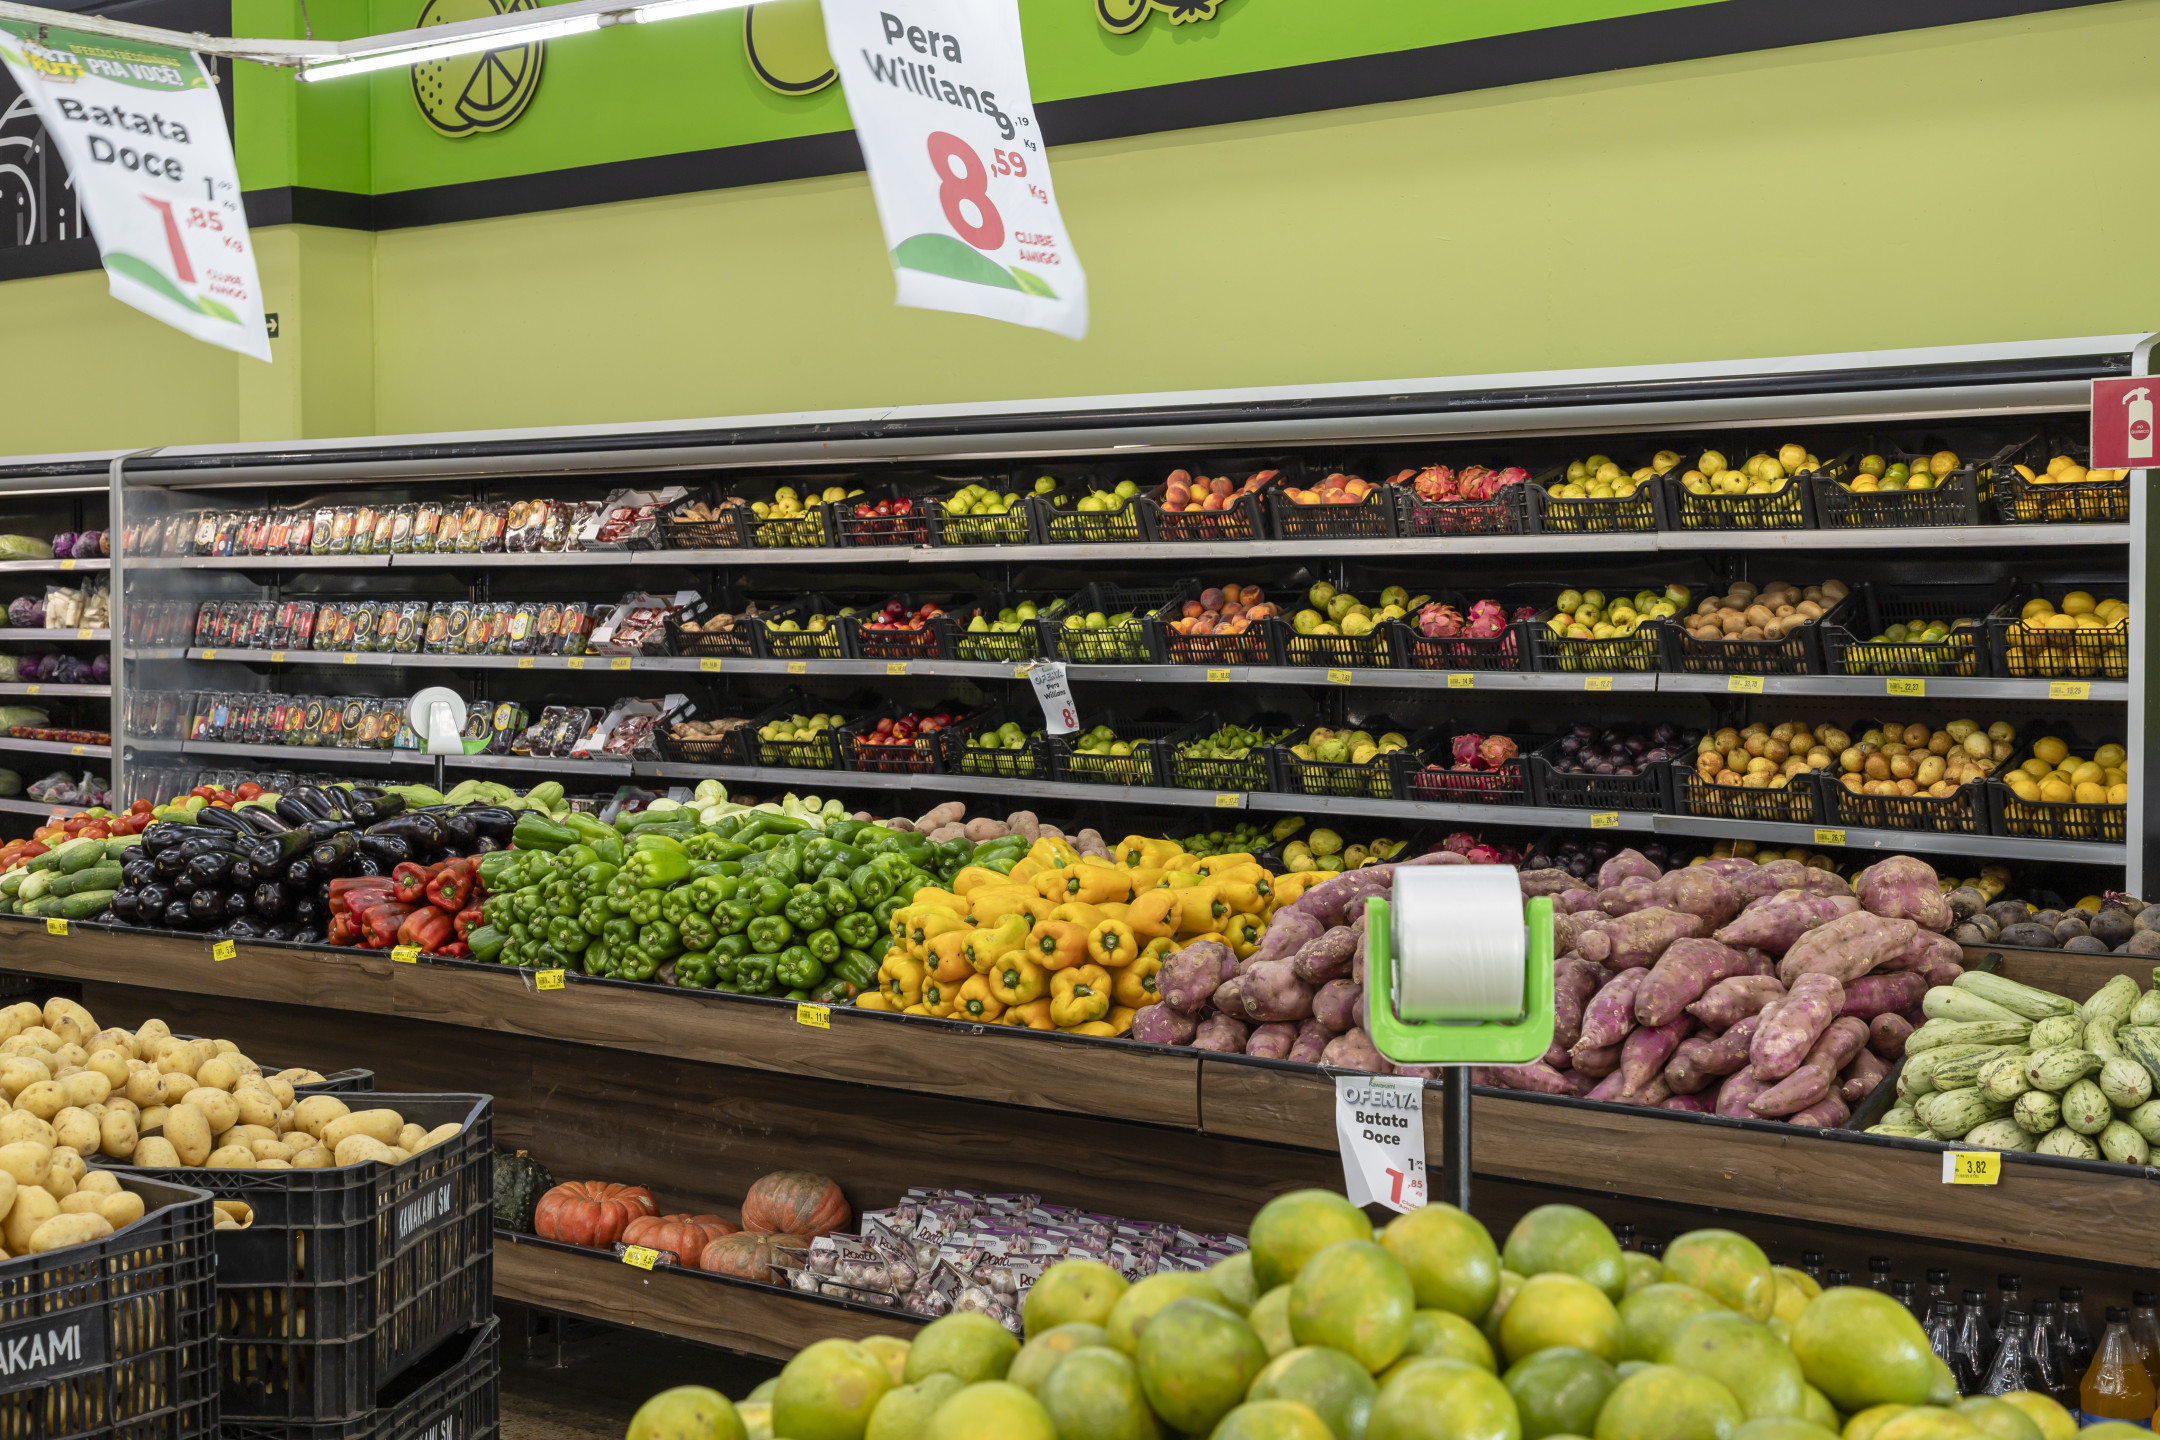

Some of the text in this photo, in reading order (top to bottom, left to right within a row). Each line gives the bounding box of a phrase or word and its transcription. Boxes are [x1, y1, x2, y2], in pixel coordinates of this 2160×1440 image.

[880, 11, 963, 64] Pera
[85, 57, 185, 87] PRA VOCÊ!
[862, 48, 999, 118] Willians
[56, 98, 191, 145] Batata
[1024, 138, 1037, 152] Kg
[88, 134, 185, 182] Doce
[1028, 184, 1049, 205] Kg
[1015, 231, 1056, 248] CLUBE
[1019, 249, 1062, 266] AMIGO
[1343, 1086, 1421, 1111] OFERTA
[1355, 1110, 1409, 1129] Batata
[1363, 1129, 1401, 1146] Doce
[1967, 1160, 1987, 1176] 3,82
[399, 1183, 451, 1240] KAWAKAMI SM
